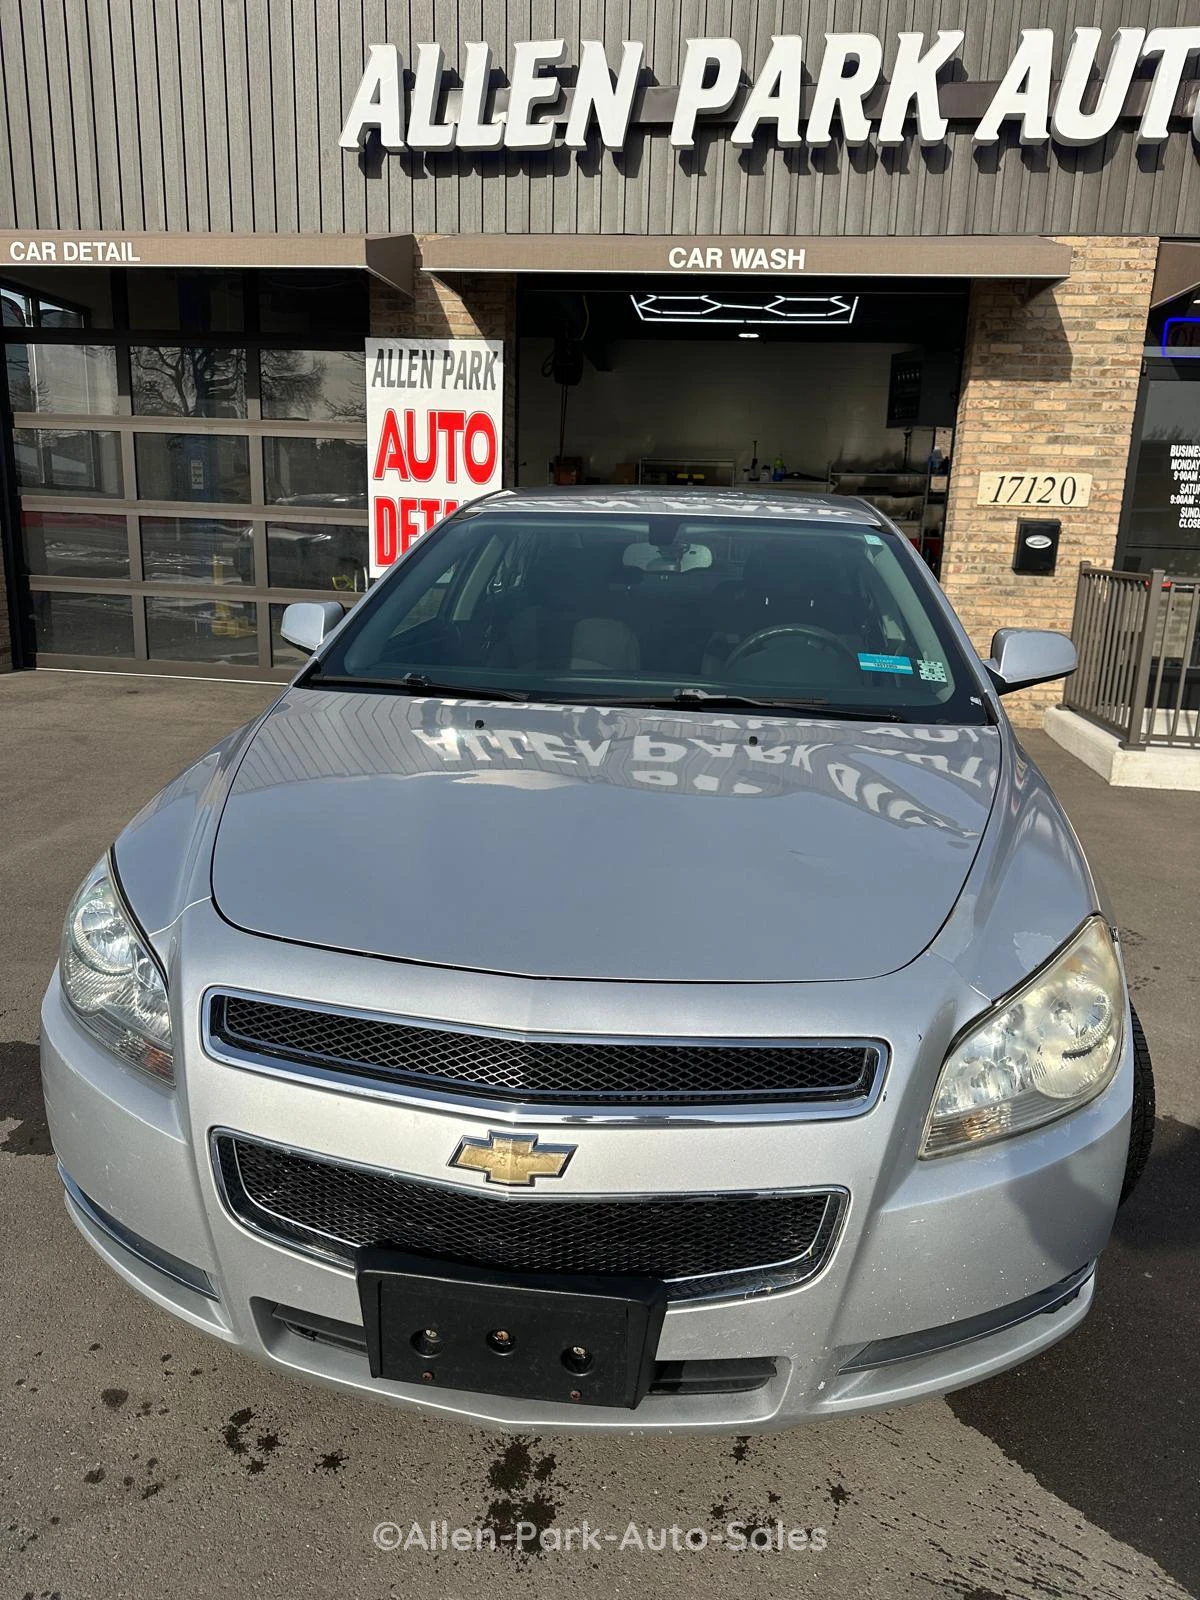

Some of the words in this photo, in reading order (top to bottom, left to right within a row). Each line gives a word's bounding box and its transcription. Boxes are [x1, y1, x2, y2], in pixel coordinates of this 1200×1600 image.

[338, 38, 644, 150] ALLEN
[671, 29, 964, 149] PARK
[971, 26, 1200, 146] AUT
[9, 241, 57, 261] CAR
[63, 241, 141, 262] DETAIL
[668, 246, 723, 269] CAR
[730, 248, 806, 270] WASH
[371, 348, 435, 389] ALLEN
[441, 350, 498, 391] PARK
[372, 407, 498, 484] AUTO
[989, 475, 1077, 505] 17120
[1169, 494, 1195, 504] 9:00AM
[1180, 507, 1200, 518] SUND
